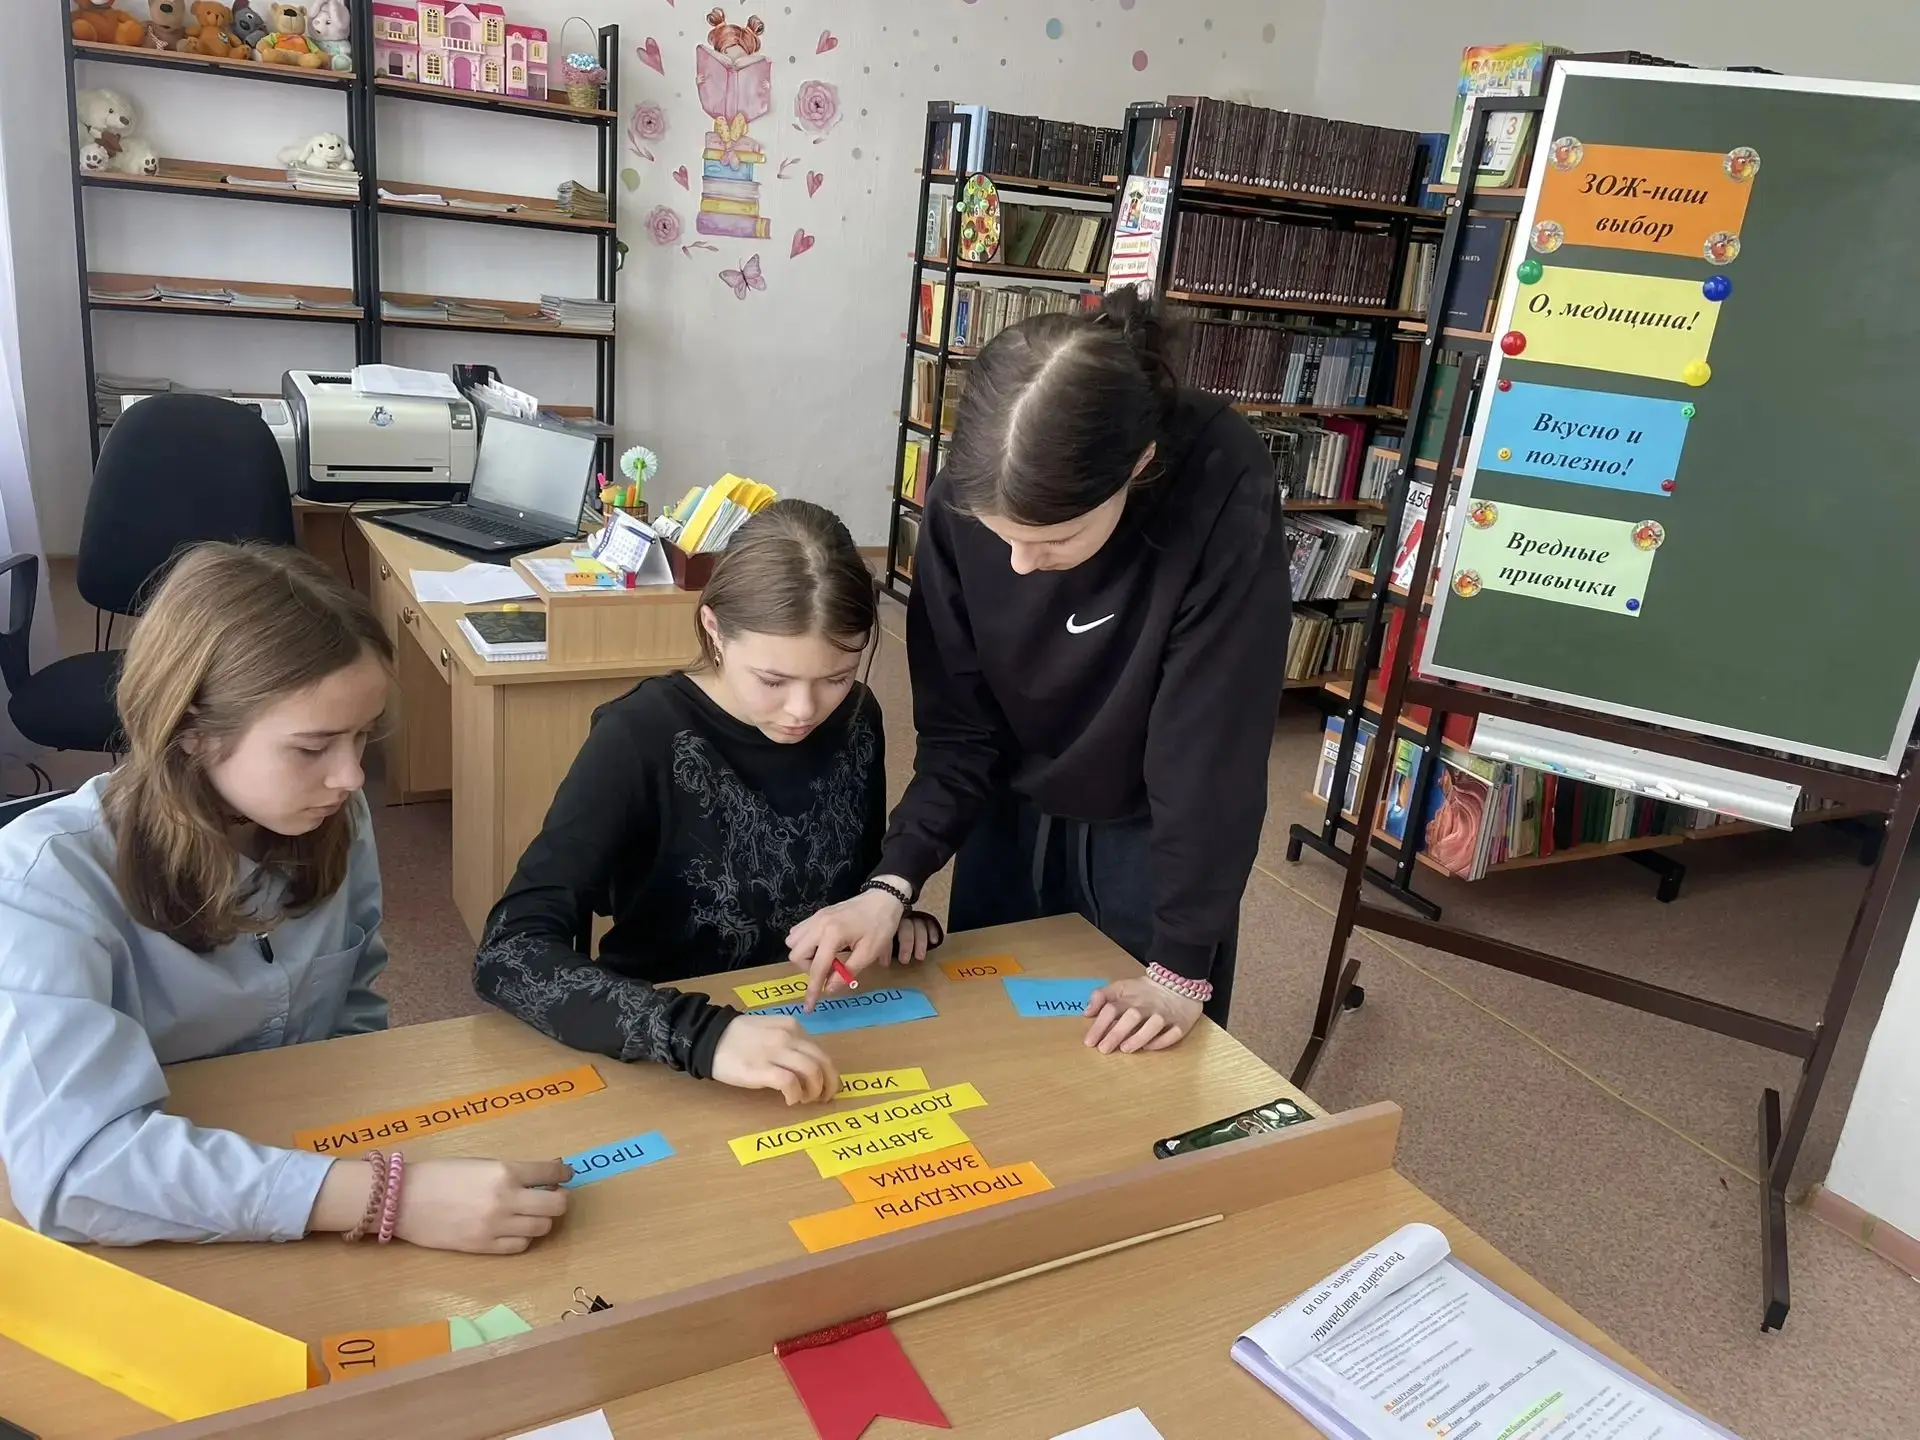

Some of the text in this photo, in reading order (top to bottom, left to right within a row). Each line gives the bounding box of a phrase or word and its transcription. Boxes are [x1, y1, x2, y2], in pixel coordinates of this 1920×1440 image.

[1507, 116, 1518, 136] 3
[1579, 173, 1709, 205] ЗОЖ-наш
[1596, 214, 1674, 242] выбор
[1528, 292, 1700, 332] О, медицина!
[1533, 412, 1644, 445] Вкусно и
[1524, 449, 1634, 477] полезно!
[1505, 531, 1610, 565] Вредные
[1498, 565, 1617, 598] привычки
[957, 965, 998, 978] СОН
[753, 981, 809, 1001] ОБЕД
[773, 990, 902, 1016] ПОСЕЩЕИЕ
[1036, 1000, 1090, 1012] ЖИН
[312, 1079, 576, 1152] СВОБОДНОЕ ВРЕМЯ
[756, 1092, 954, 1153] ДОРОГА В ШКОЛУ
[832, 1127, 934, 1161] ЗАВТРАК
[870, 1154, 980, 1188] ЗАРЯДКА
[874, 1171, 1024, 1220] ПРОЦЕДУРЫ
[1358, 1251, 1405, 1296] Разгадайте
[1302, 1302, 1314, 1316] из
[1313, 1286, 1333, 1305] что
[1310, 1289, 1361, 1342] анаграммы.
[337, 1337, 377, 1370] 10
